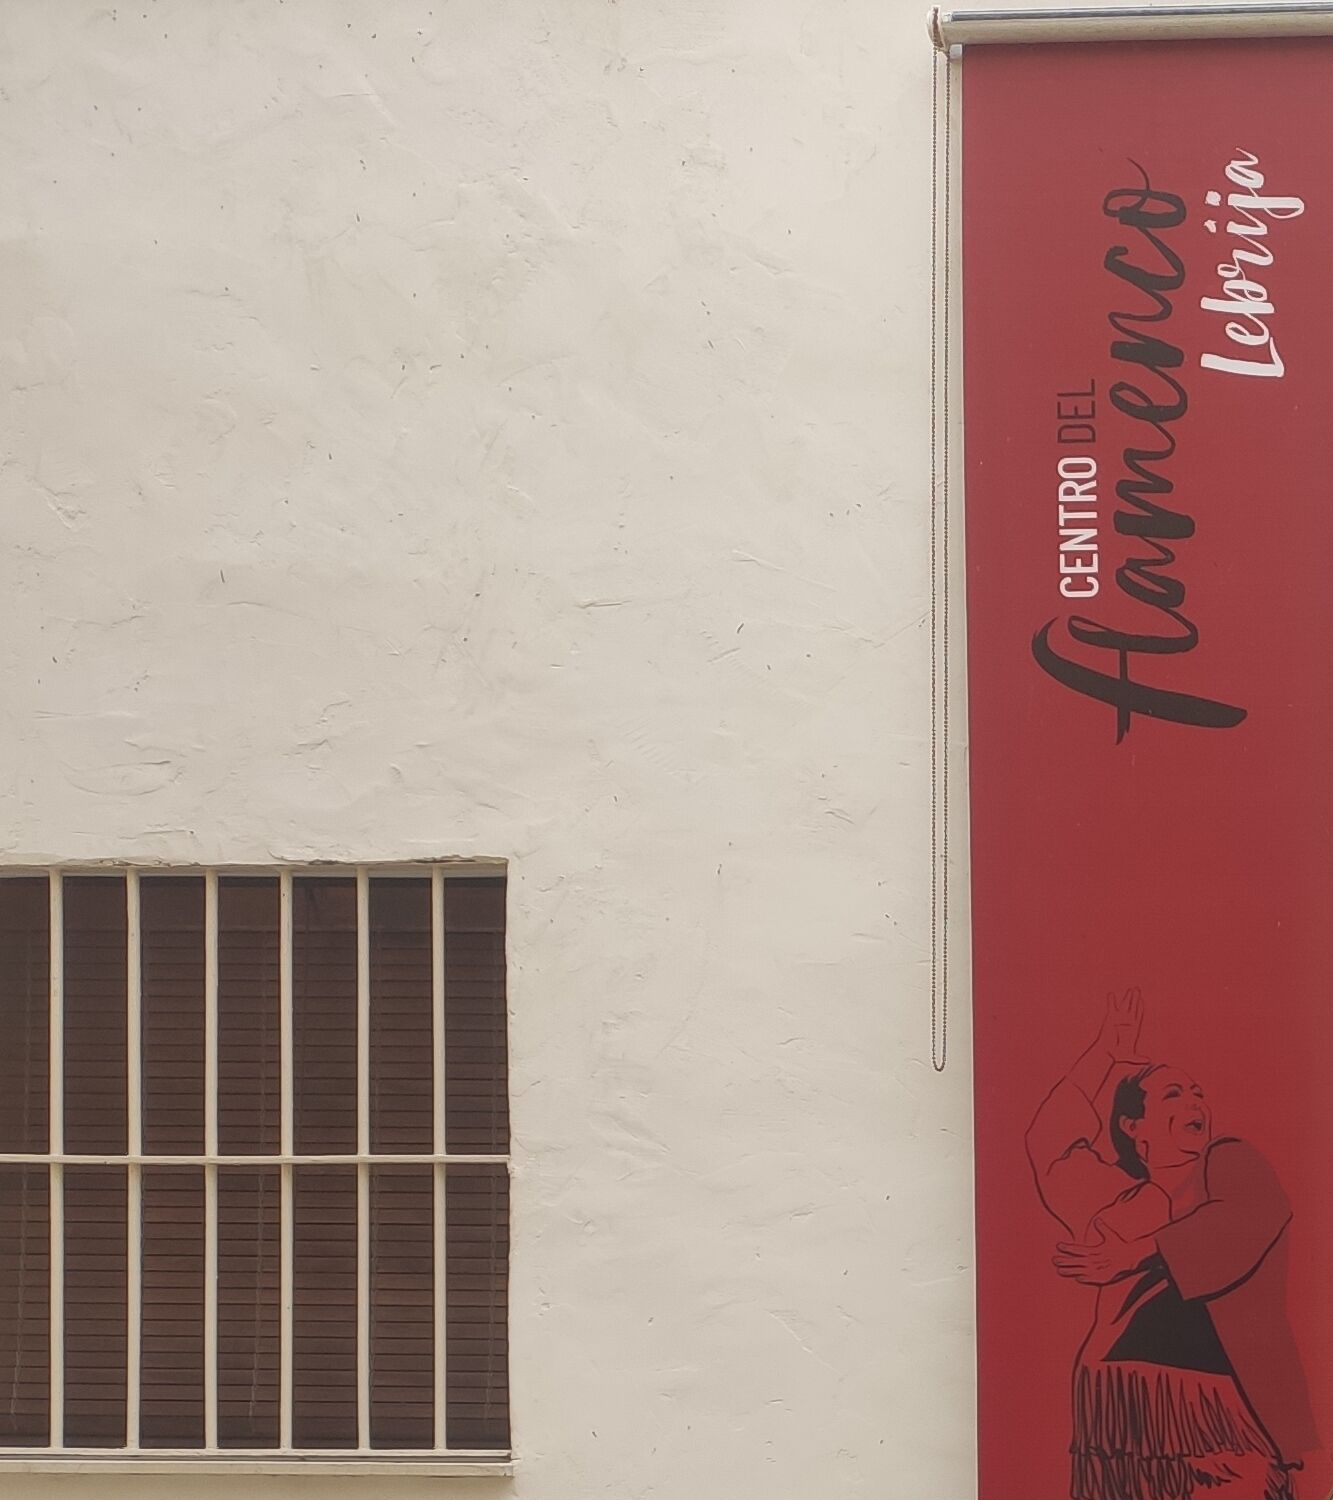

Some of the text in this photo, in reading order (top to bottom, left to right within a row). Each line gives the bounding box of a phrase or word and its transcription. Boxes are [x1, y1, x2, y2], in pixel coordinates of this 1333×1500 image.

[1200, 147, 1304, 378] Lebrija
[1031, 157, 1248, 745] flamenco
[1057, 378, 1099, 599] CENTRO DEL
